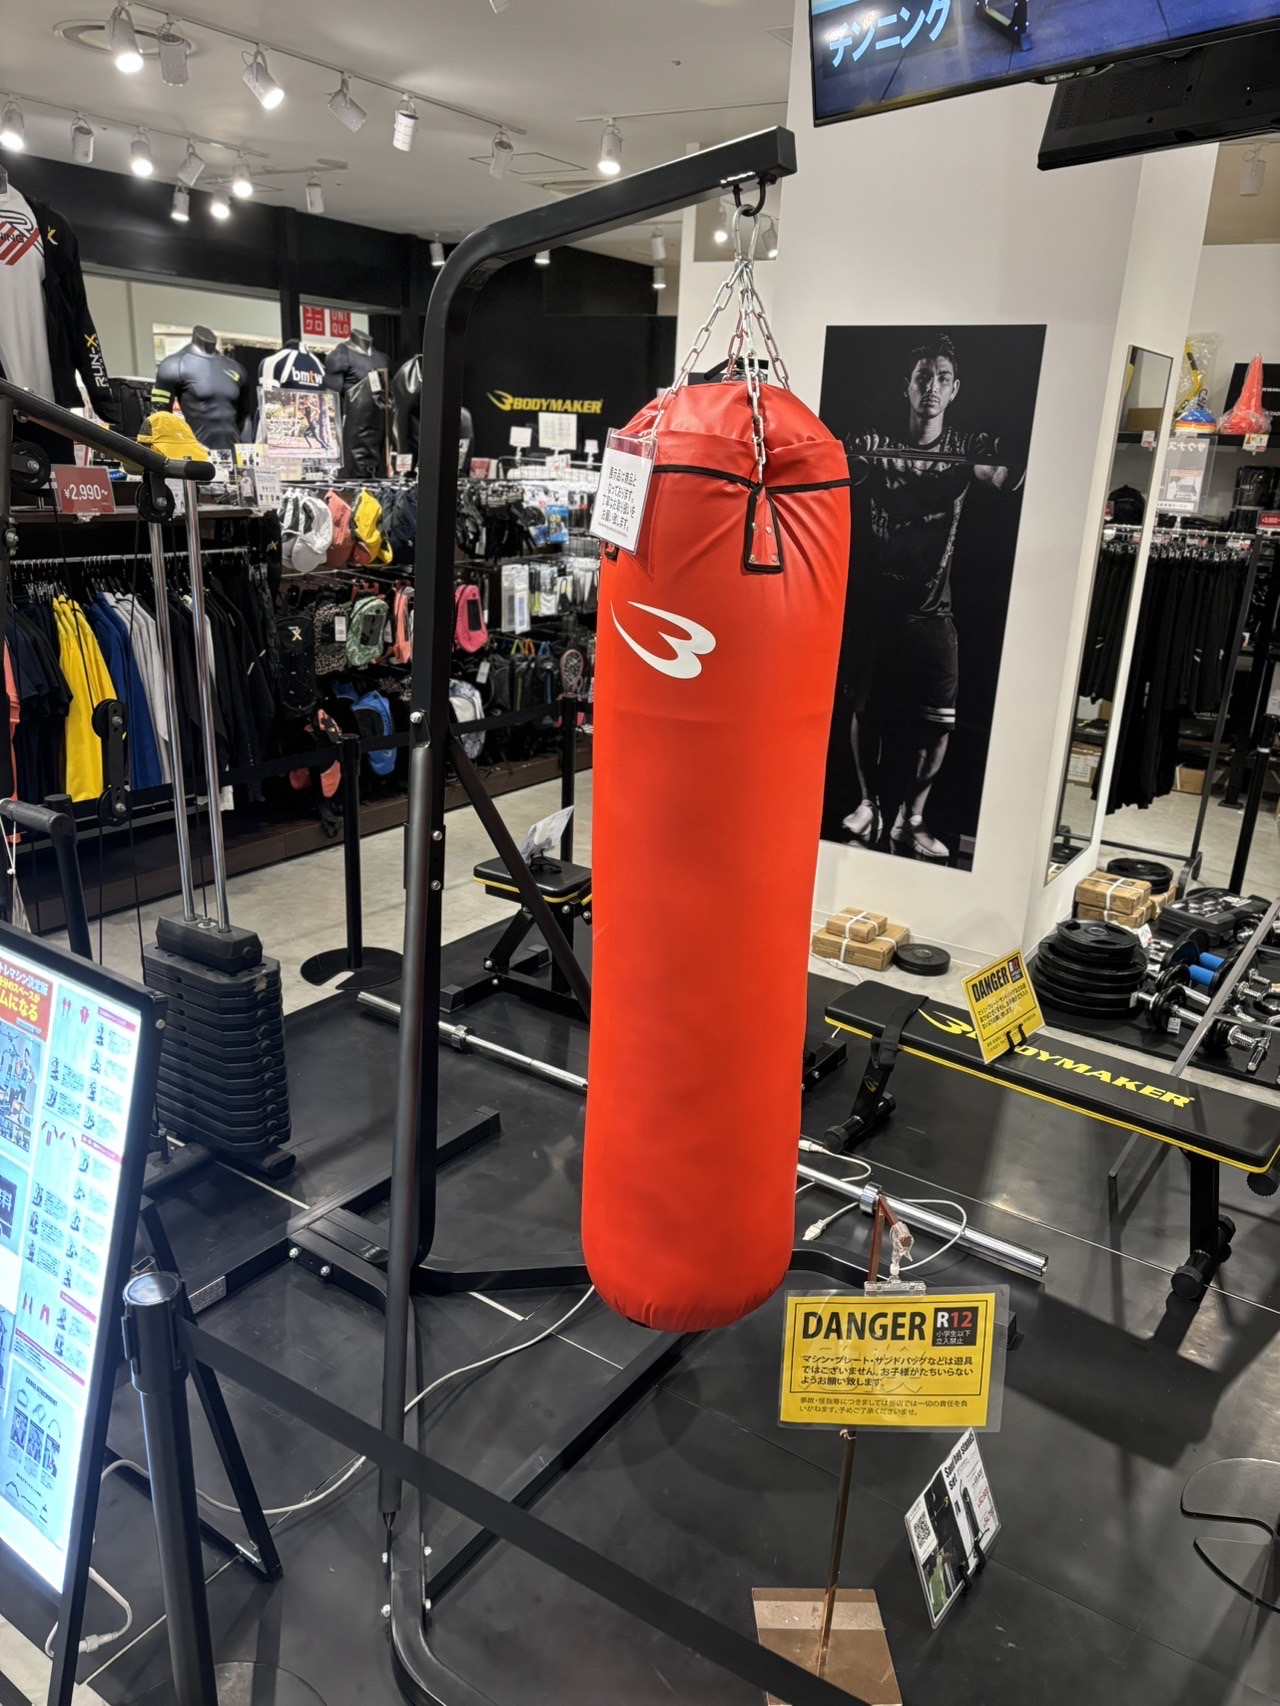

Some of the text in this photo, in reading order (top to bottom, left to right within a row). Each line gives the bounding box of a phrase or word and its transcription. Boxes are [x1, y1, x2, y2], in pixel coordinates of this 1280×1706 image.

[331, 322, 350, 335] QLO
[512, 397, 603, 414] BODYMAKER
[971, 966, 1010, 1003] DANGER
[802, 1311, 973, 1341] DANGER R12
[935, 1329, 972, 1338] 小学生以下
[935, 1337, 964, 1345] 立入禁止
